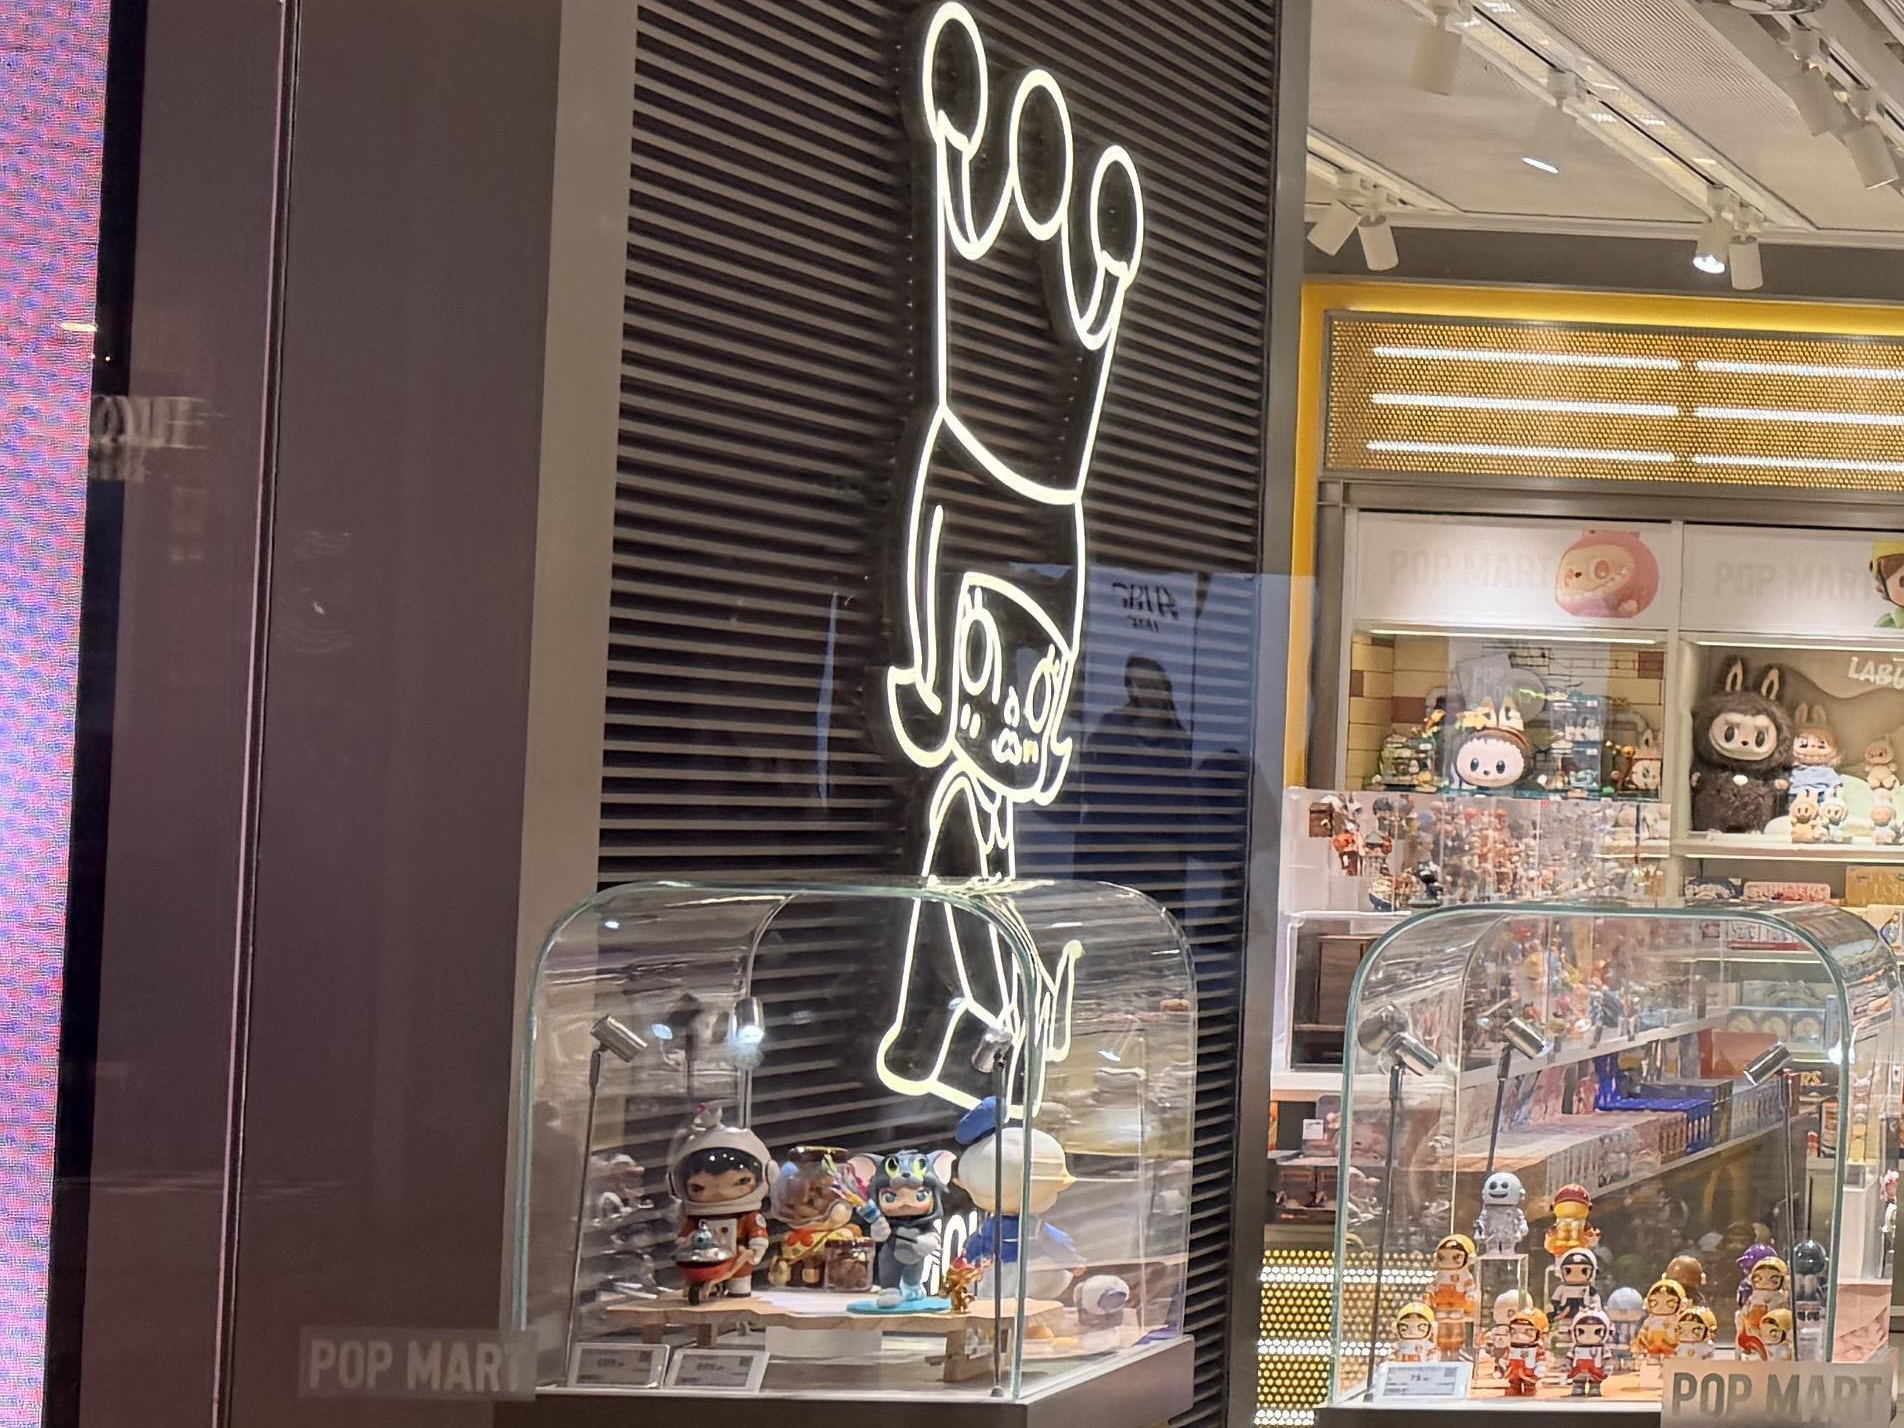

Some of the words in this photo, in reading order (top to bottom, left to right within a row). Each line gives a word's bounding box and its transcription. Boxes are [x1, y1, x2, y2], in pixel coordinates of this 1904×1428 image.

[309, 1339, 394, 1390] POP
[406, 1339, 526, 1393] MART
[1672, 1371, 1753, 1419] POP
[1765, 1373, 1883, 1423] MART
